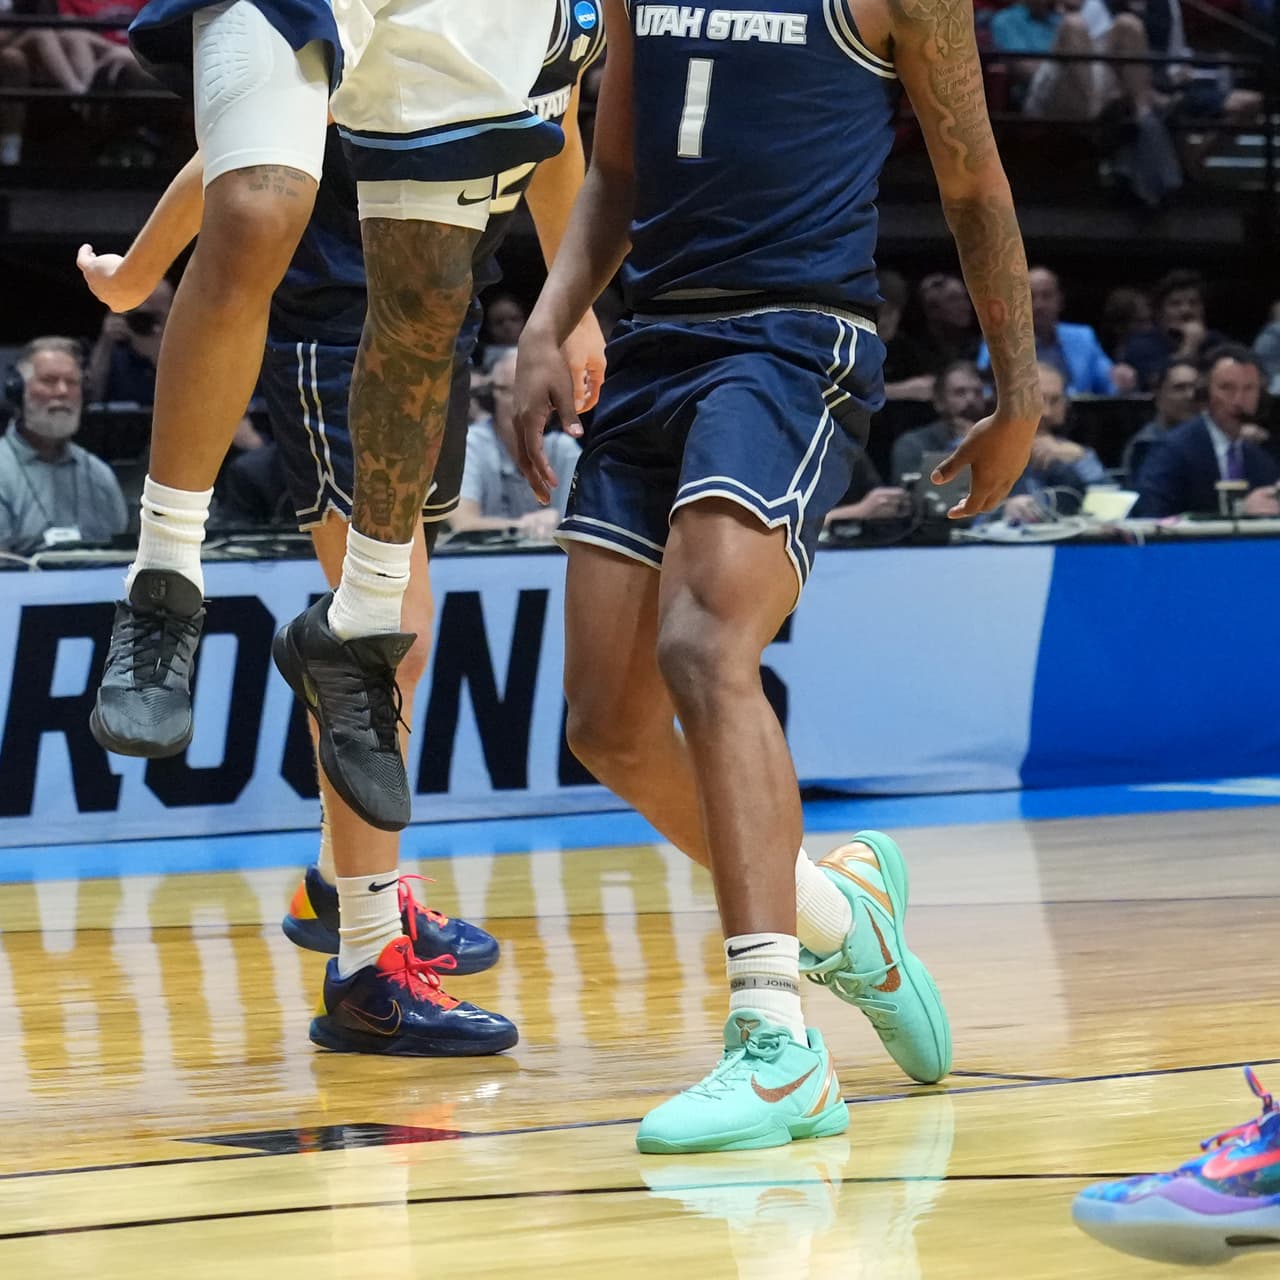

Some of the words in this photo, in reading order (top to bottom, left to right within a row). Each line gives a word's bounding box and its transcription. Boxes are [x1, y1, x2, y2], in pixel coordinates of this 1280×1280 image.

[635, 4, 706, 39] UTAH
[706, 9, 808, 45] STATE
[677, 57, 714, 159] 1
